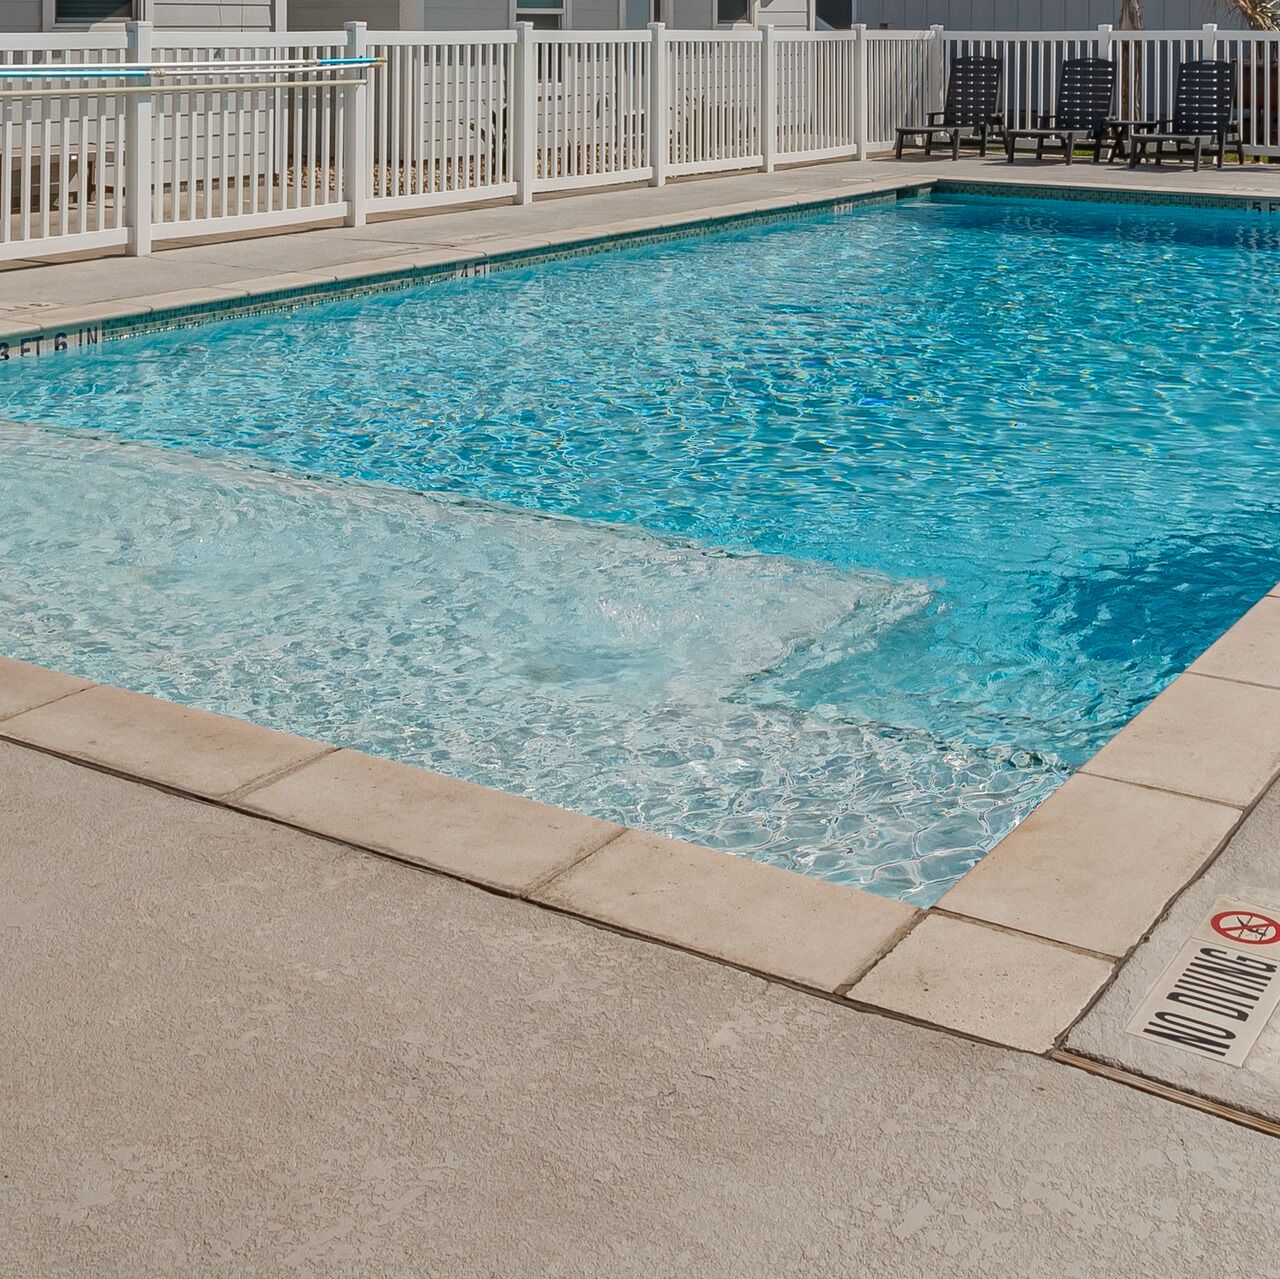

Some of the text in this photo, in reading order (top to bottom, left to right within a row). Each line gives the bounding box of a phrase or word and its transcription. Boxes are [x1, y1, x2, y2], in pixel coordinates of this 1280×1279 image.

[1252, 201, 1262, 212] 5
[20, 335, 44, 357] FT
[54, 332, 68, 351] 6
[78, 325, 98, 347] IN
[1143, 946, 1278, 1057] NO DIVING
